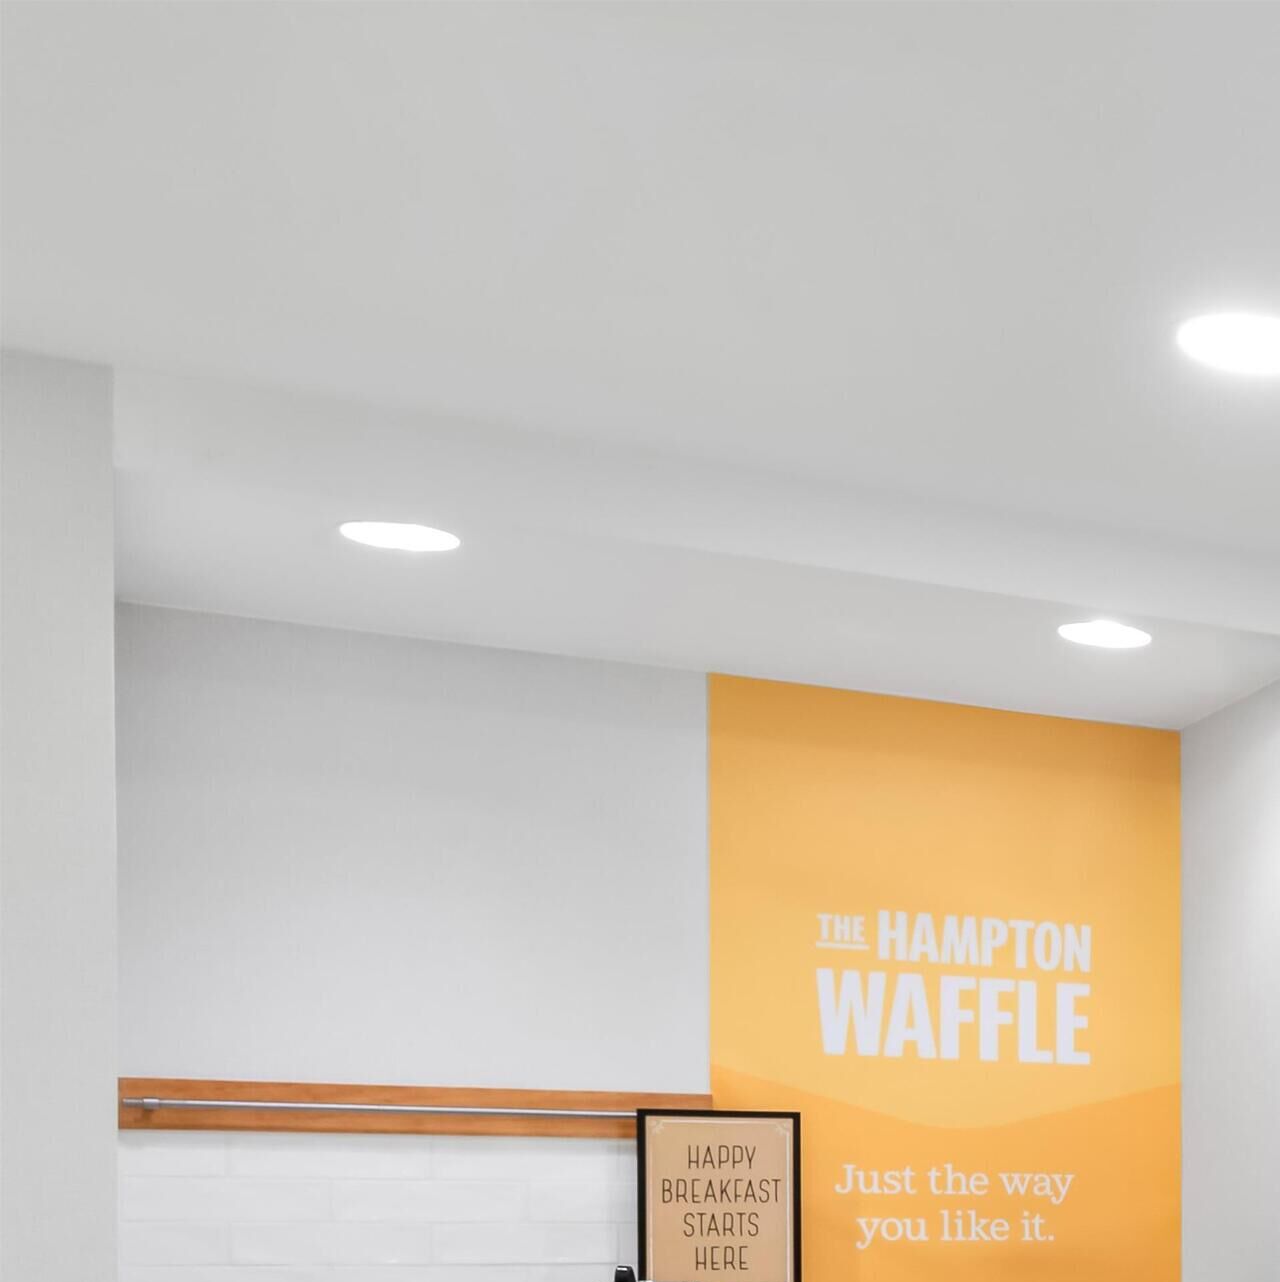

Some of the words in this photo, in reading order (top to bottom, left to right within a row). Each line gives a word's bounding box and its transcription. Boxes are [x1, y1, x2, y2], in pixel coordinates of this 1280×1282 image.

[816, 912, 866, 942] THE
[877, 909, 1091, 972] HAMPTON
[815, 967, 1091, 1065] WAFFLE
[687, 1145, 757, 1170] HAPPY
[661, 1178, 782, 1204] BREAKFAST
[835, 1163, 915, 1195] Just
[928, 1163, 990, 1195] the
[1000, 1172, 1074, 1204] way
[682, 1212, 760, 1238] STARTS
[856, 1217, 929, 1249] you
[941, 1209, 1010, 1241] like
[1021, 1211, 1055, 1242] it.
[694, 1245, 750, 1271] HERE
